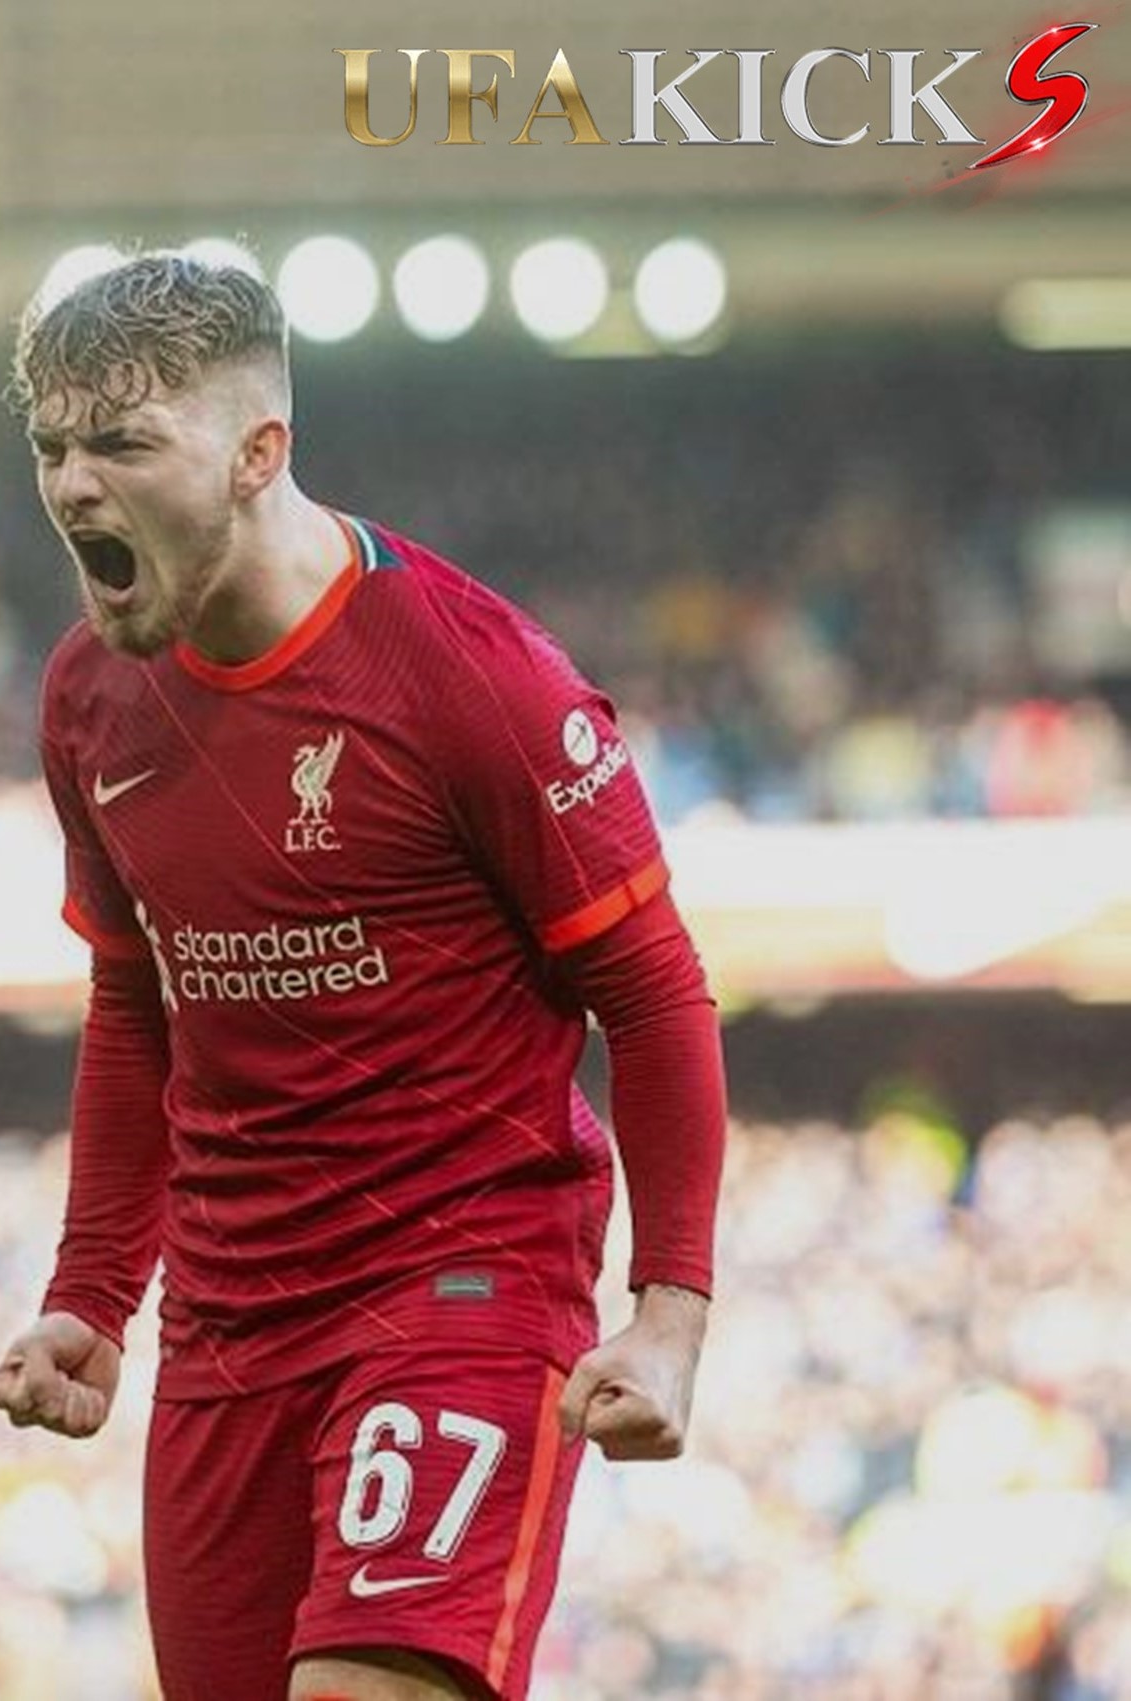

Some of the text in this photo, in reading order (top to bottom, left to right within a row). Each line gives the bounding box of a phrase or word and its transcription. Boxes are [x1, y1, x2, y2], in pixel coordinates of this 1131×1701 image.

[173, 916, 365, 962] standard
[180, 946, 388, 1000] chartered
[339, 1402, 507, 1562] 67
